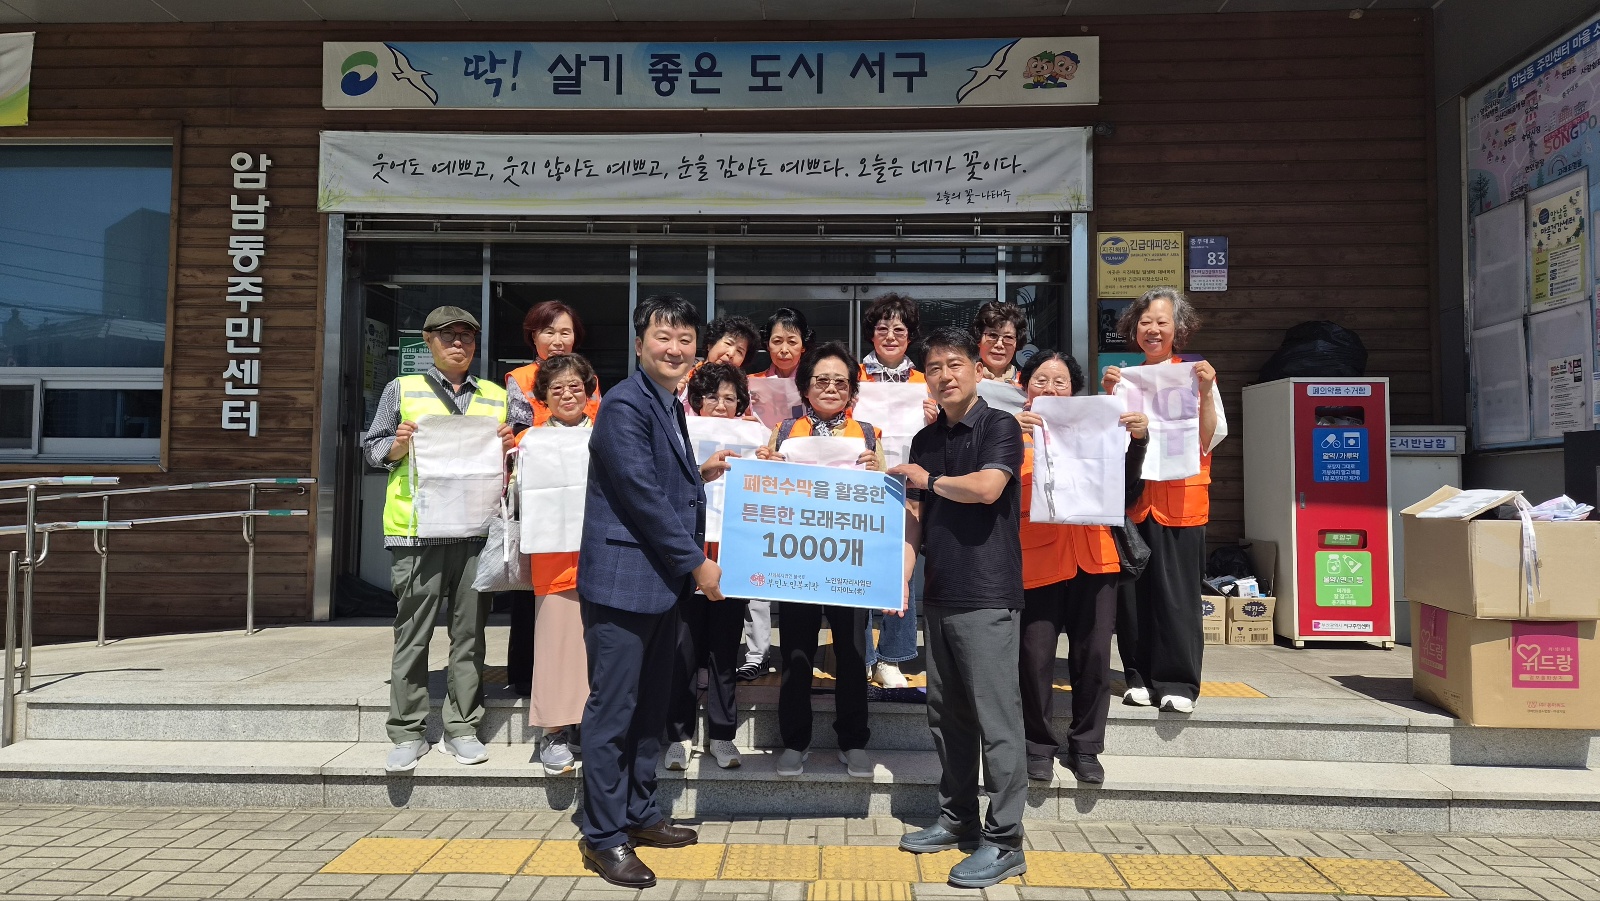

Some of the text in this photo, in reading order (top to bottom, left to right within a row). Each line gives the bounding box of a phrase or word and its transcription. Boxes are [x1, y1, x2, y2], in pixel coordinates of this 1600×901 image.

[1511, 65, 1535, 89] 암남동
[1536, 41, 1571, 72] 주민센터
[1572, 28, 1591, 49] 마을
[463, 50, 928, 98] 딱! 살기 좋은 도시 서구
[1543, 114, 1598, 156] SONGDO
[372, 150, 1027, 187] 웃어도 예쁘고, 웃지 않아도 예쁘고, 눈을 감아도 예쁘다. 오늘은 네가 꽃이다.
[935, 190, 962, 203] 오늘의
[1550, 203, 1568, 222] 암남동
[1130, 239, 1180, 251] 긴급대피장소
[1207, 252, 1226, 265] 83
[221, 151, 273, 437] 암남동주민센터
[1312, 386, 1366, 395] 폐의약품 수거함
[743, 474, 887, 504] 폐현수막을 활용한
[742, 503, 886, 533] 튼튼한 모래주머니
[762, 531, 864, 567] 1000개
[1332, 534, 1353, 542] 투입구
[825, 577, 872, 588] 노인일자리사업단
[1244, 604, 1265, 612] 박카스
[1517, 645, 1573, 671] 위드랑
